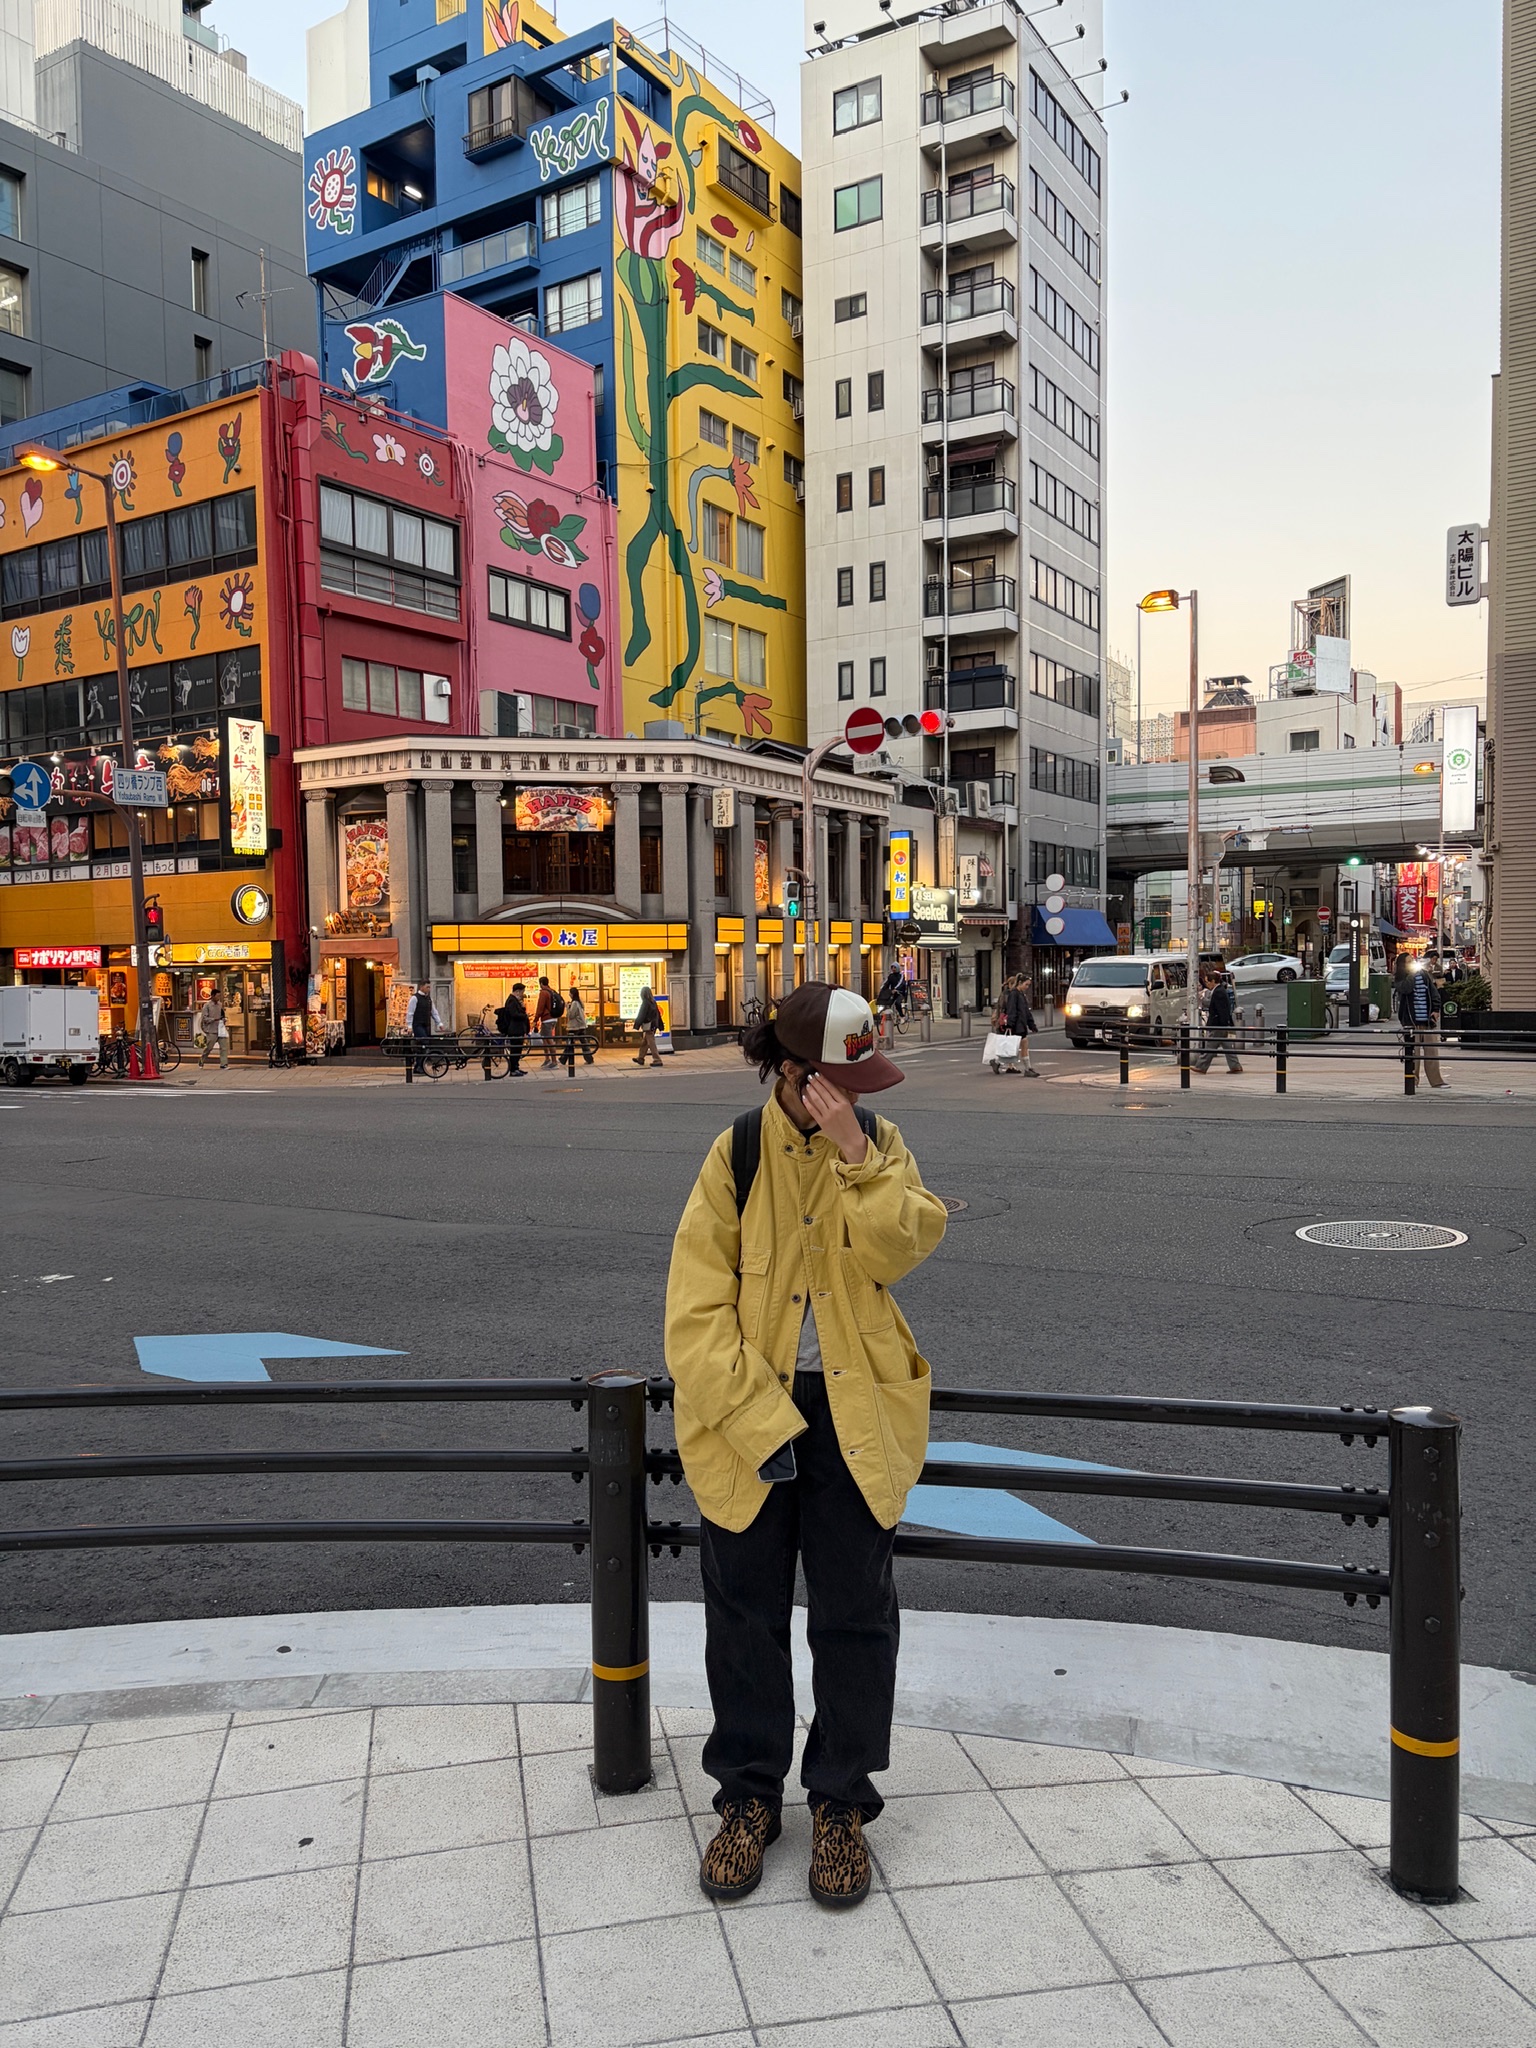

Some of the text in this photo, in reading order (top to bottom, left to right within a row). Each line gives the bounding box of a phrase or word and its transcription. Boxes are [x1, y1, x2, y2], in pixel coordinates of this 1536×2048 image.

[1457, 530, 1475, 597] 太陽ビル
[117, 773, 162, 791] 四ツ橋ランプ西
[118, 791, 141, 801] Yotsubashi
[143, 792, 156, 803] Ramp
[525, 794, 595, 814] HAFEZ
[894, 870, 907, 900] 松屋
[913, 903, 948, 921] SeekeR
[1401, 893, 1417, 923] 大たこ
[558, 929, 598, 946] 松屋
[31, 950, 93, 966] ナポリタン専門店
